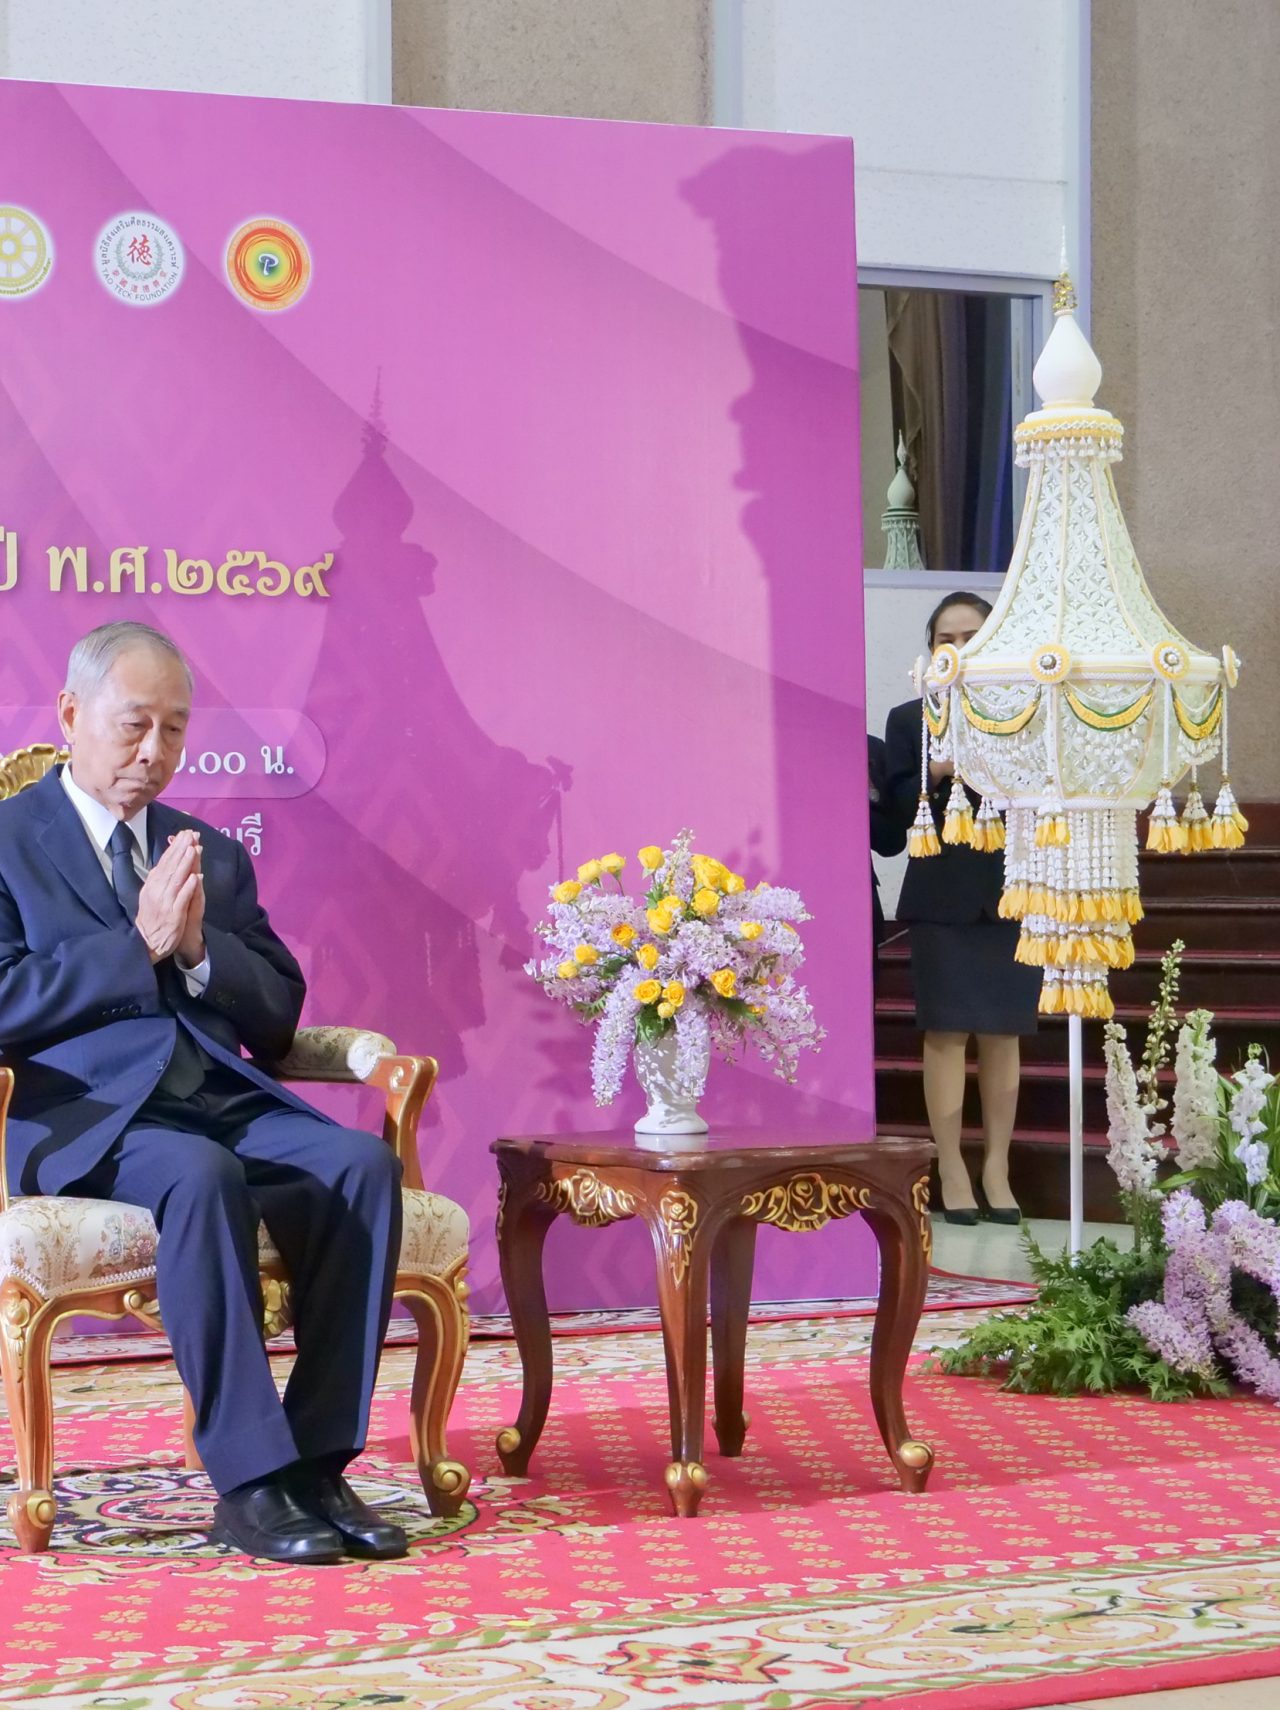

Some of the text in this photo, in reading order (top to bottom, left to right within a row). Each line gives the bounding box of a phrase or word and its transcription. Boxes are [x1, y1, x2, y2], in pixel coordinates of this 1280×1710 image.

[135, 271, 179, 302] FOUNDATION
[46, 545, 334, 597] พ.ศ.๒๕๖๙
[261, 745, 294, 774] น.
